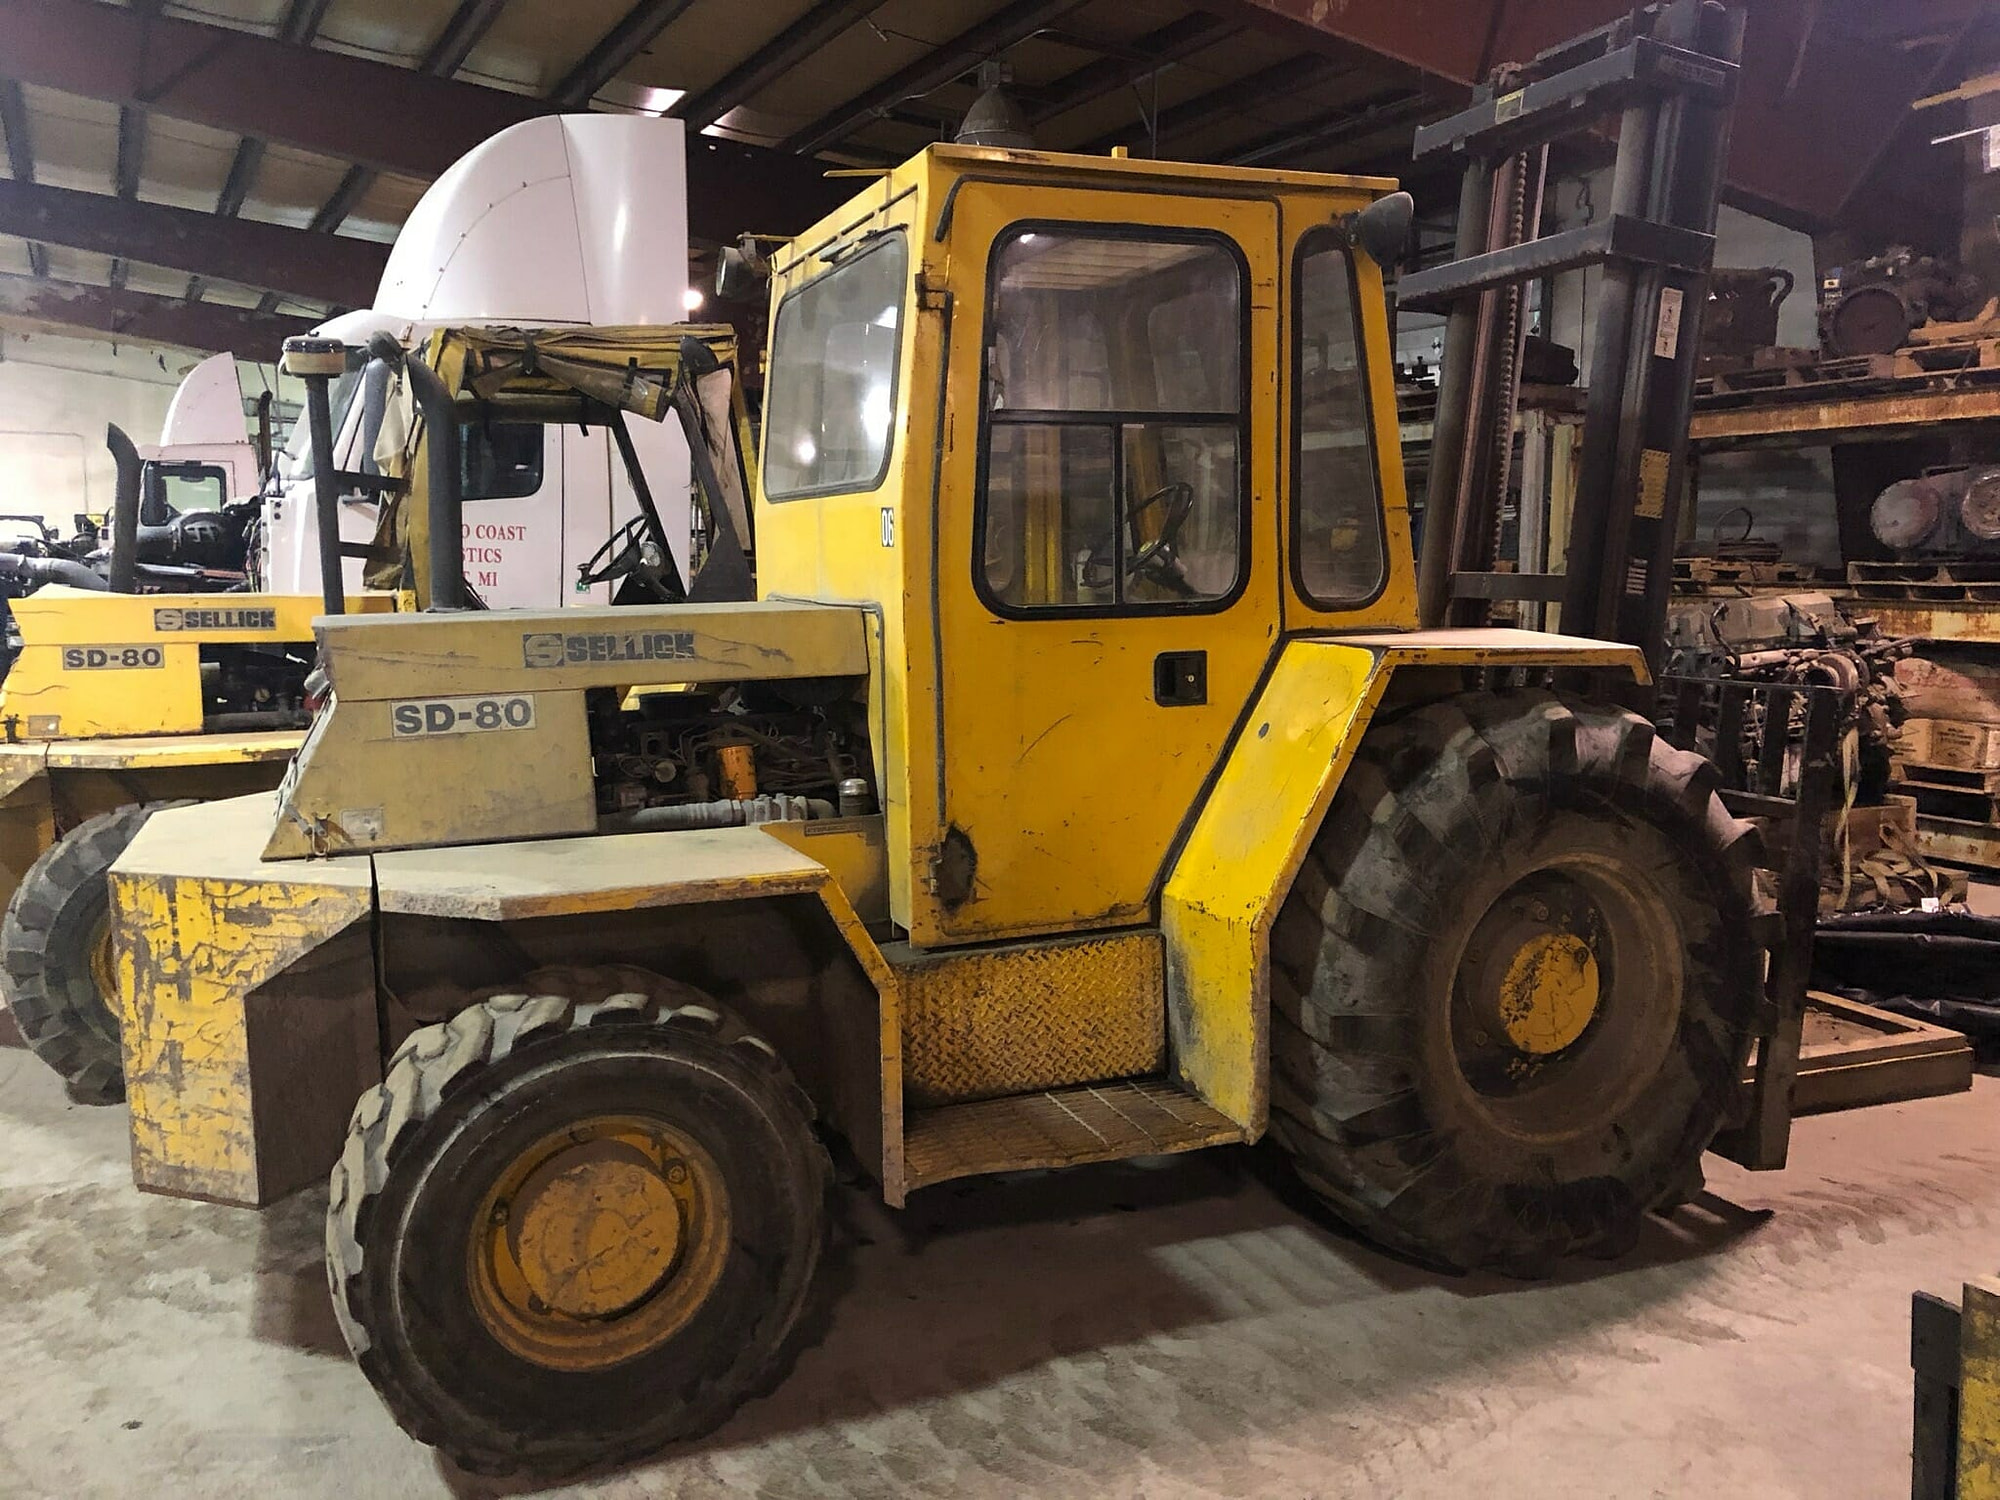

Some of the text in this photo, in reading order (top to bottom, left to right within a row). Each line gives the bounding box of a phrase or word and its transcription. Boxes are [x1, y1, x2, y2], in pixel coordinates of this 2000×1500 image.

[475, 524, 527, 541] COAST
[881, 508, 894, 547] 06
[478, 571, 498, 587] MI
[184, 610, 276, 628] SELLICK
[566, 633, 696, 662] SELLICK
[65, 648, 161, 668] SD-80
[395, 699, 532, 734] SD-80
